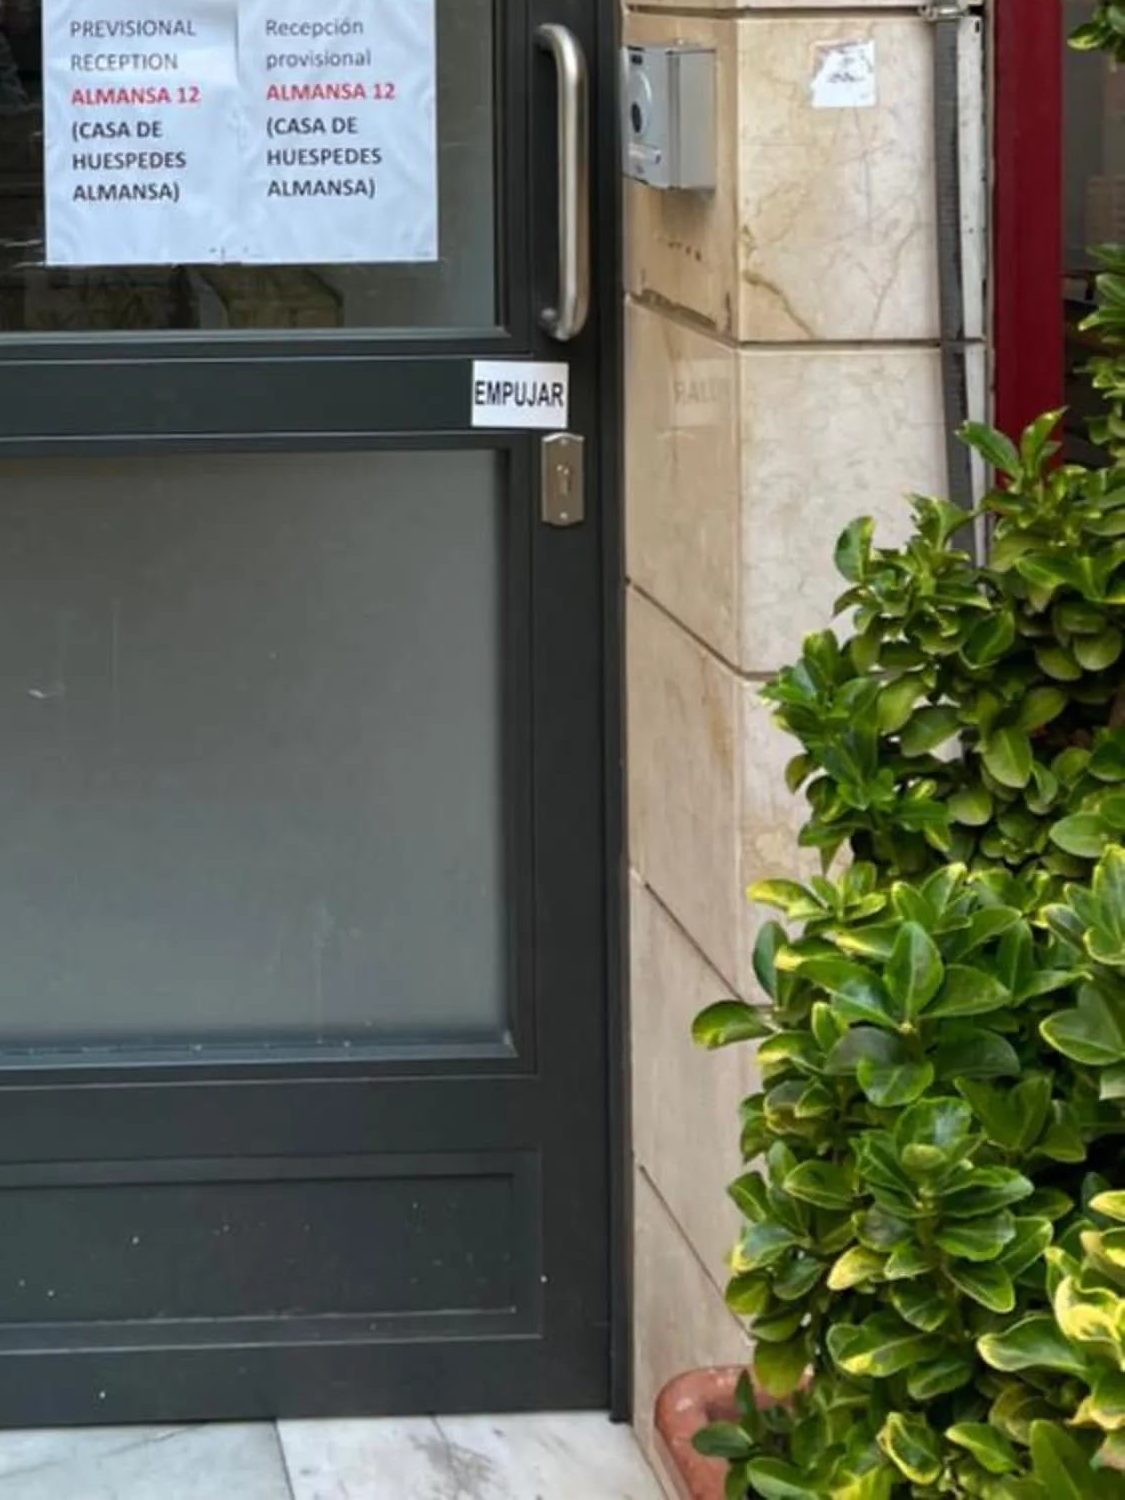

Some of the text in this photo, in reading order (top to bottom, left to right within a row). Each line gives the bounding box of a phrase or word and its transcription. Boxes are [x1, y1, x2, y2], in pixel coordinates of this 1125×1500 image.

[70, 19, 197, 37] PREVISIONAL
[265, 16, 364, 38] Recepción
[70, 52, 179, 71] RECEPTION
[266, 48, 372, 70] provisional
[71, 85, 201, 105] ALMANSA 12
[266, 81, 396, 101] ALMANSA 12
[71, 120, 164, 141] (CASA DE
[266, 115, 358, 138] (CASA DE
[71, 151, 187, 170] HUESPEDES
[266, 147, 382, 166] HUESPEDES
[73, 180, 180, 203] ALMANSA)
[266, 177, 376, 199] ALMANSA)
[474, 380, 565, 407] EMPUJAR
